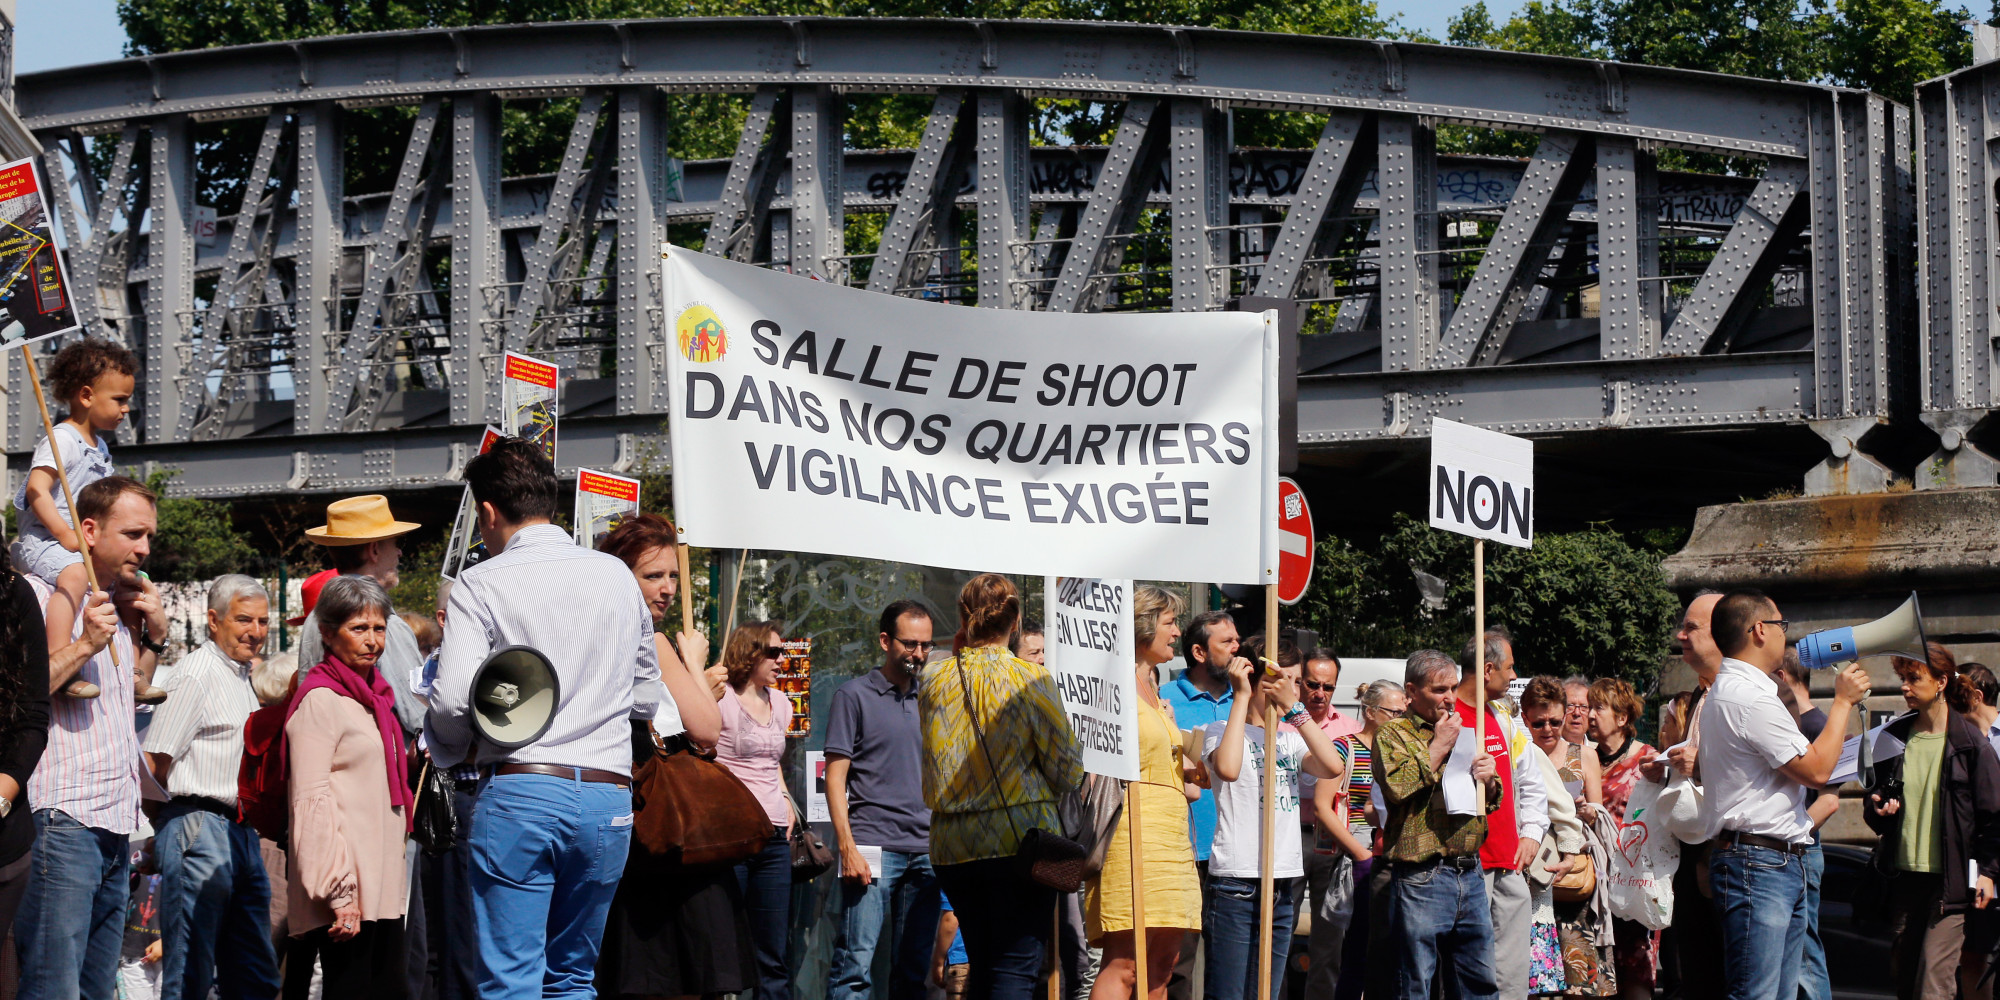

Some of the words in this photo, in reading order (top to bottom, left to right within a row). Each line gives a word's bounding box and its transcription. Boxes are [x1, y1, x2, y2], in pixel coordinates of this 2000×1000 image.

[751, 319, 939, 395] SALLE
[948, 357, 1027, 404] DE
[1036, 363, 1197, 407] SHOOT
[686, 371, 829, 434] DANS
[839, 399, 951, 455] NOS
[965, 419, 1250, 465] QUARTIERS
[744, 441, 1010, 521] VIGILANCE
[1021, 472, 1209, 525] EXIGÉE
[1436, 465, 1530, 540] NON
[1074, 618, 1119, 656] LIESS
[1057, 672, 1121, 716] HABITANTS
